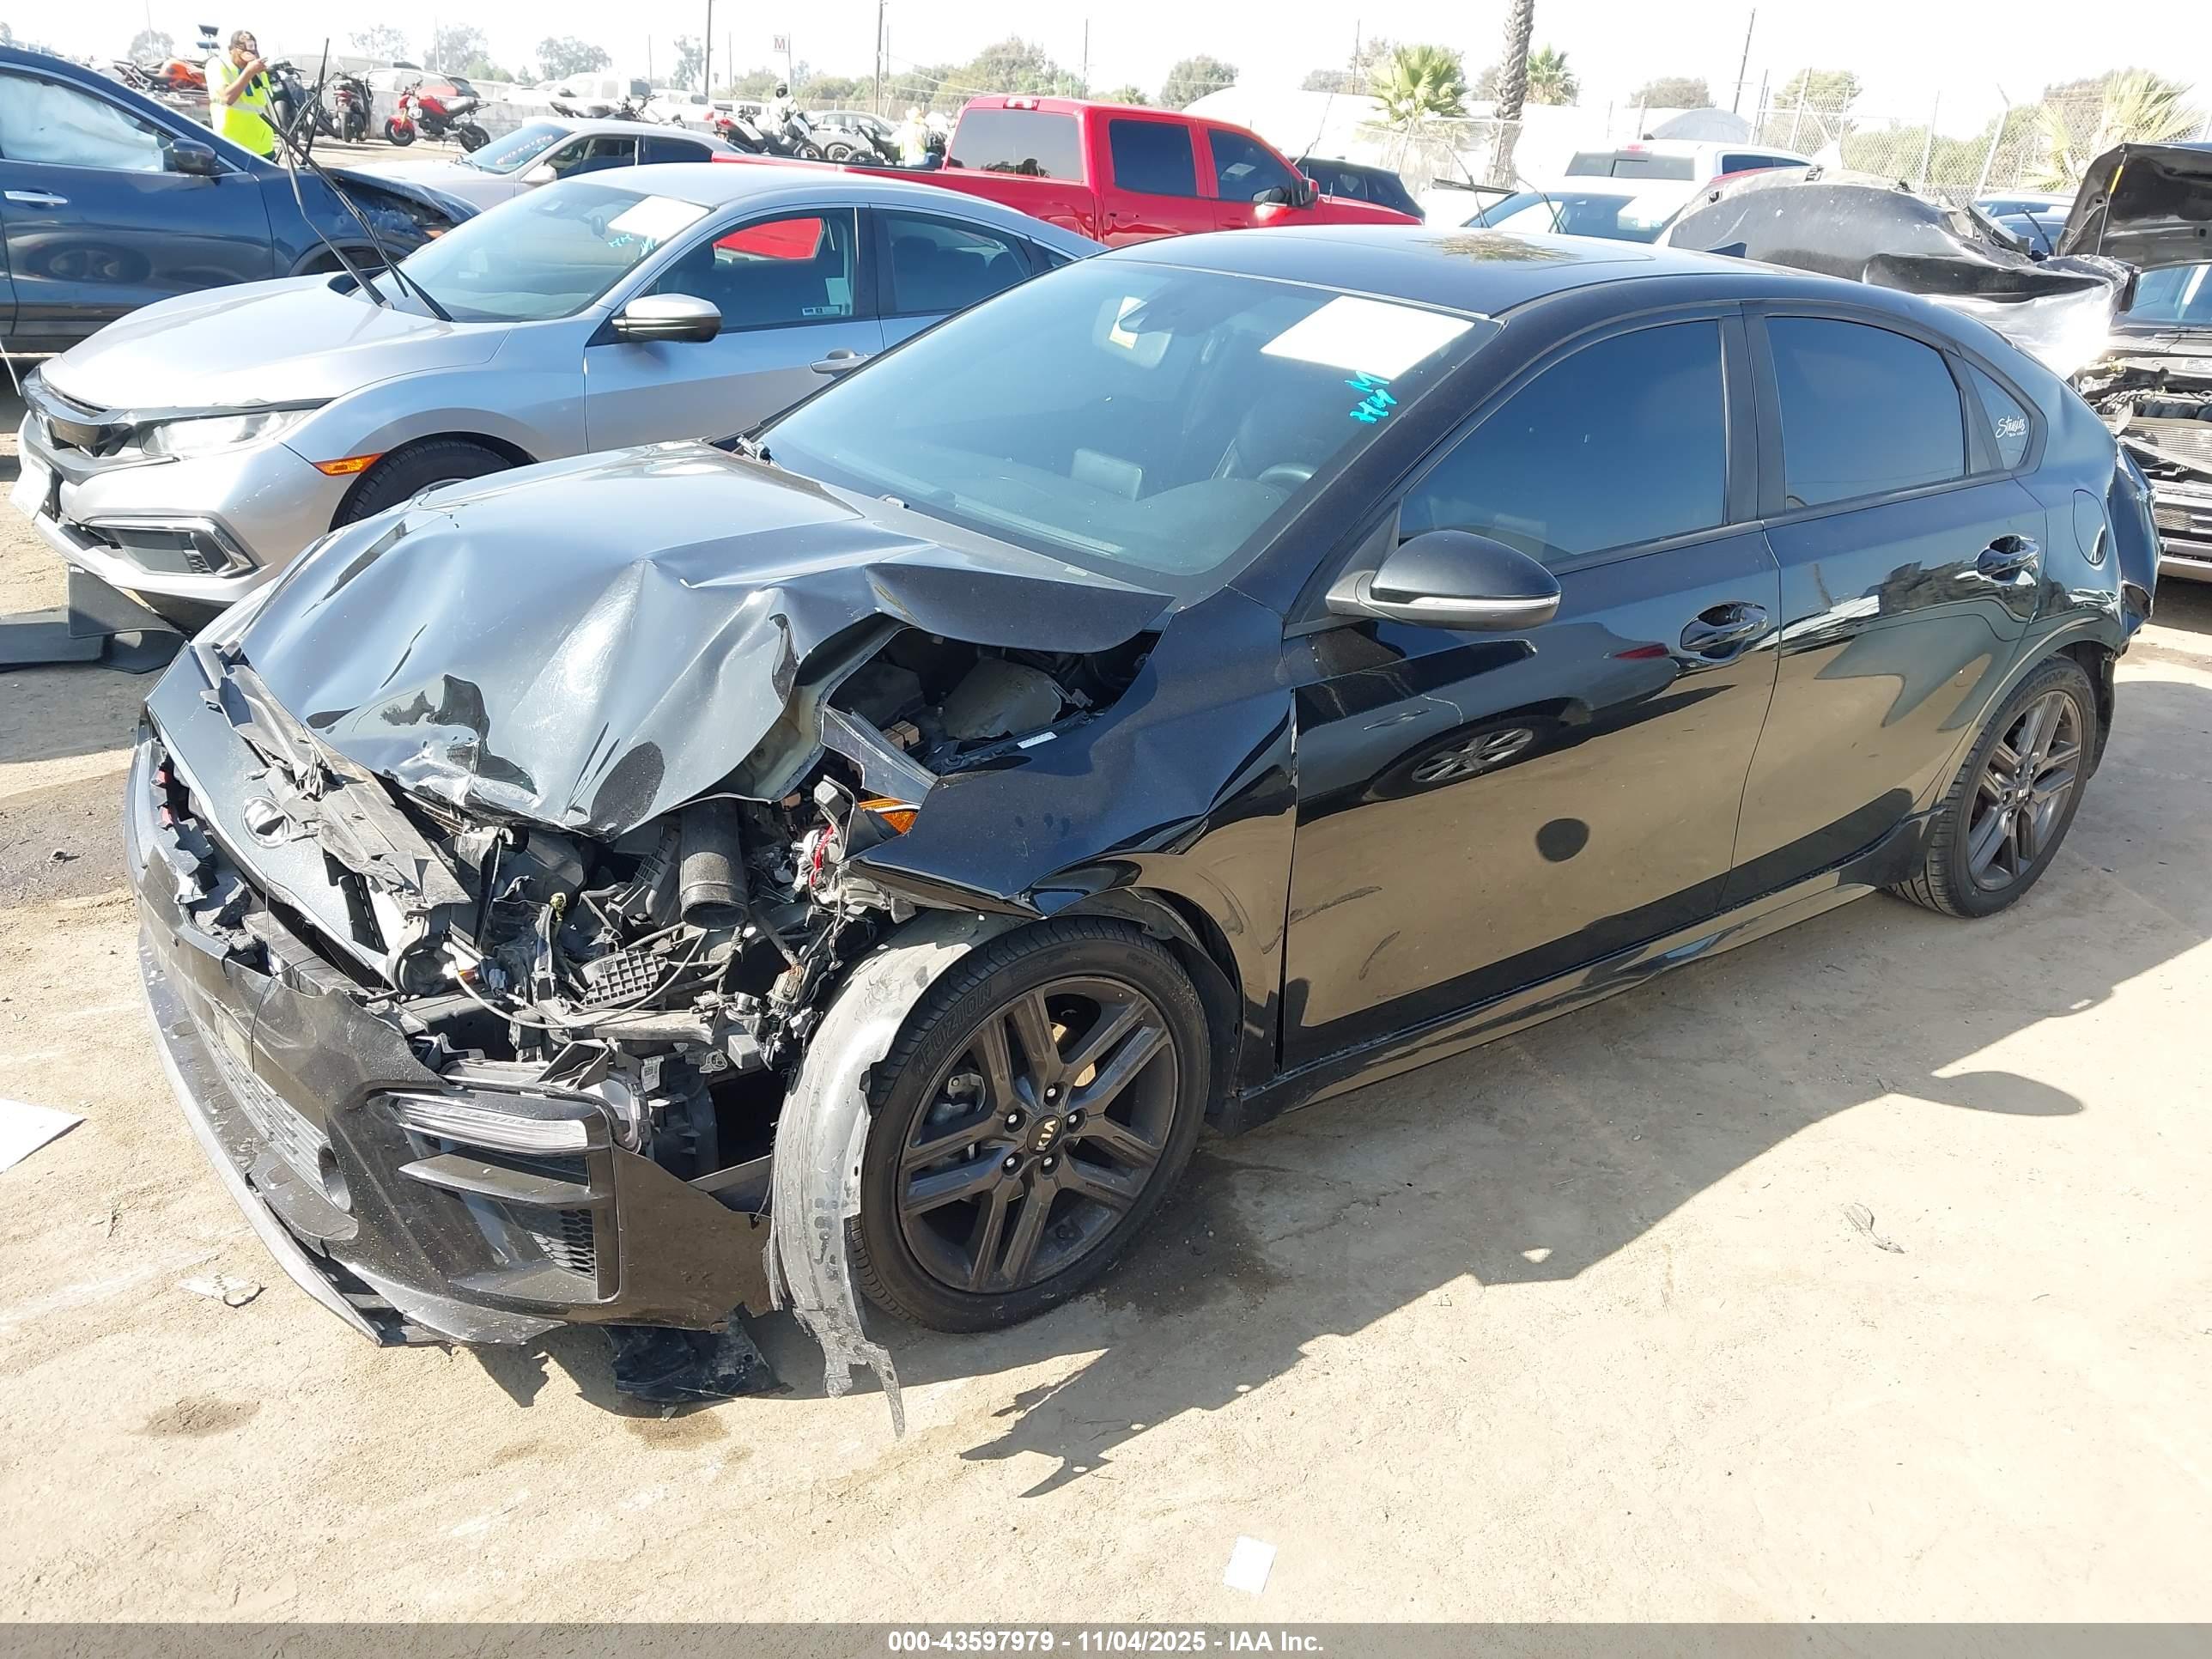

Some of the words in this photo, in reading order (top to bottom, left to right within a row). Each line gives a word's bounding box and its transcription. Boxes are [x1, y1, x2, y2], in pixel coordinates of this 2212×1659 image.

[774, 37, 786, 51] M
[920, 981, 993, 1066] FUZION
[1036, 1120, 1056, 1152] KIA
